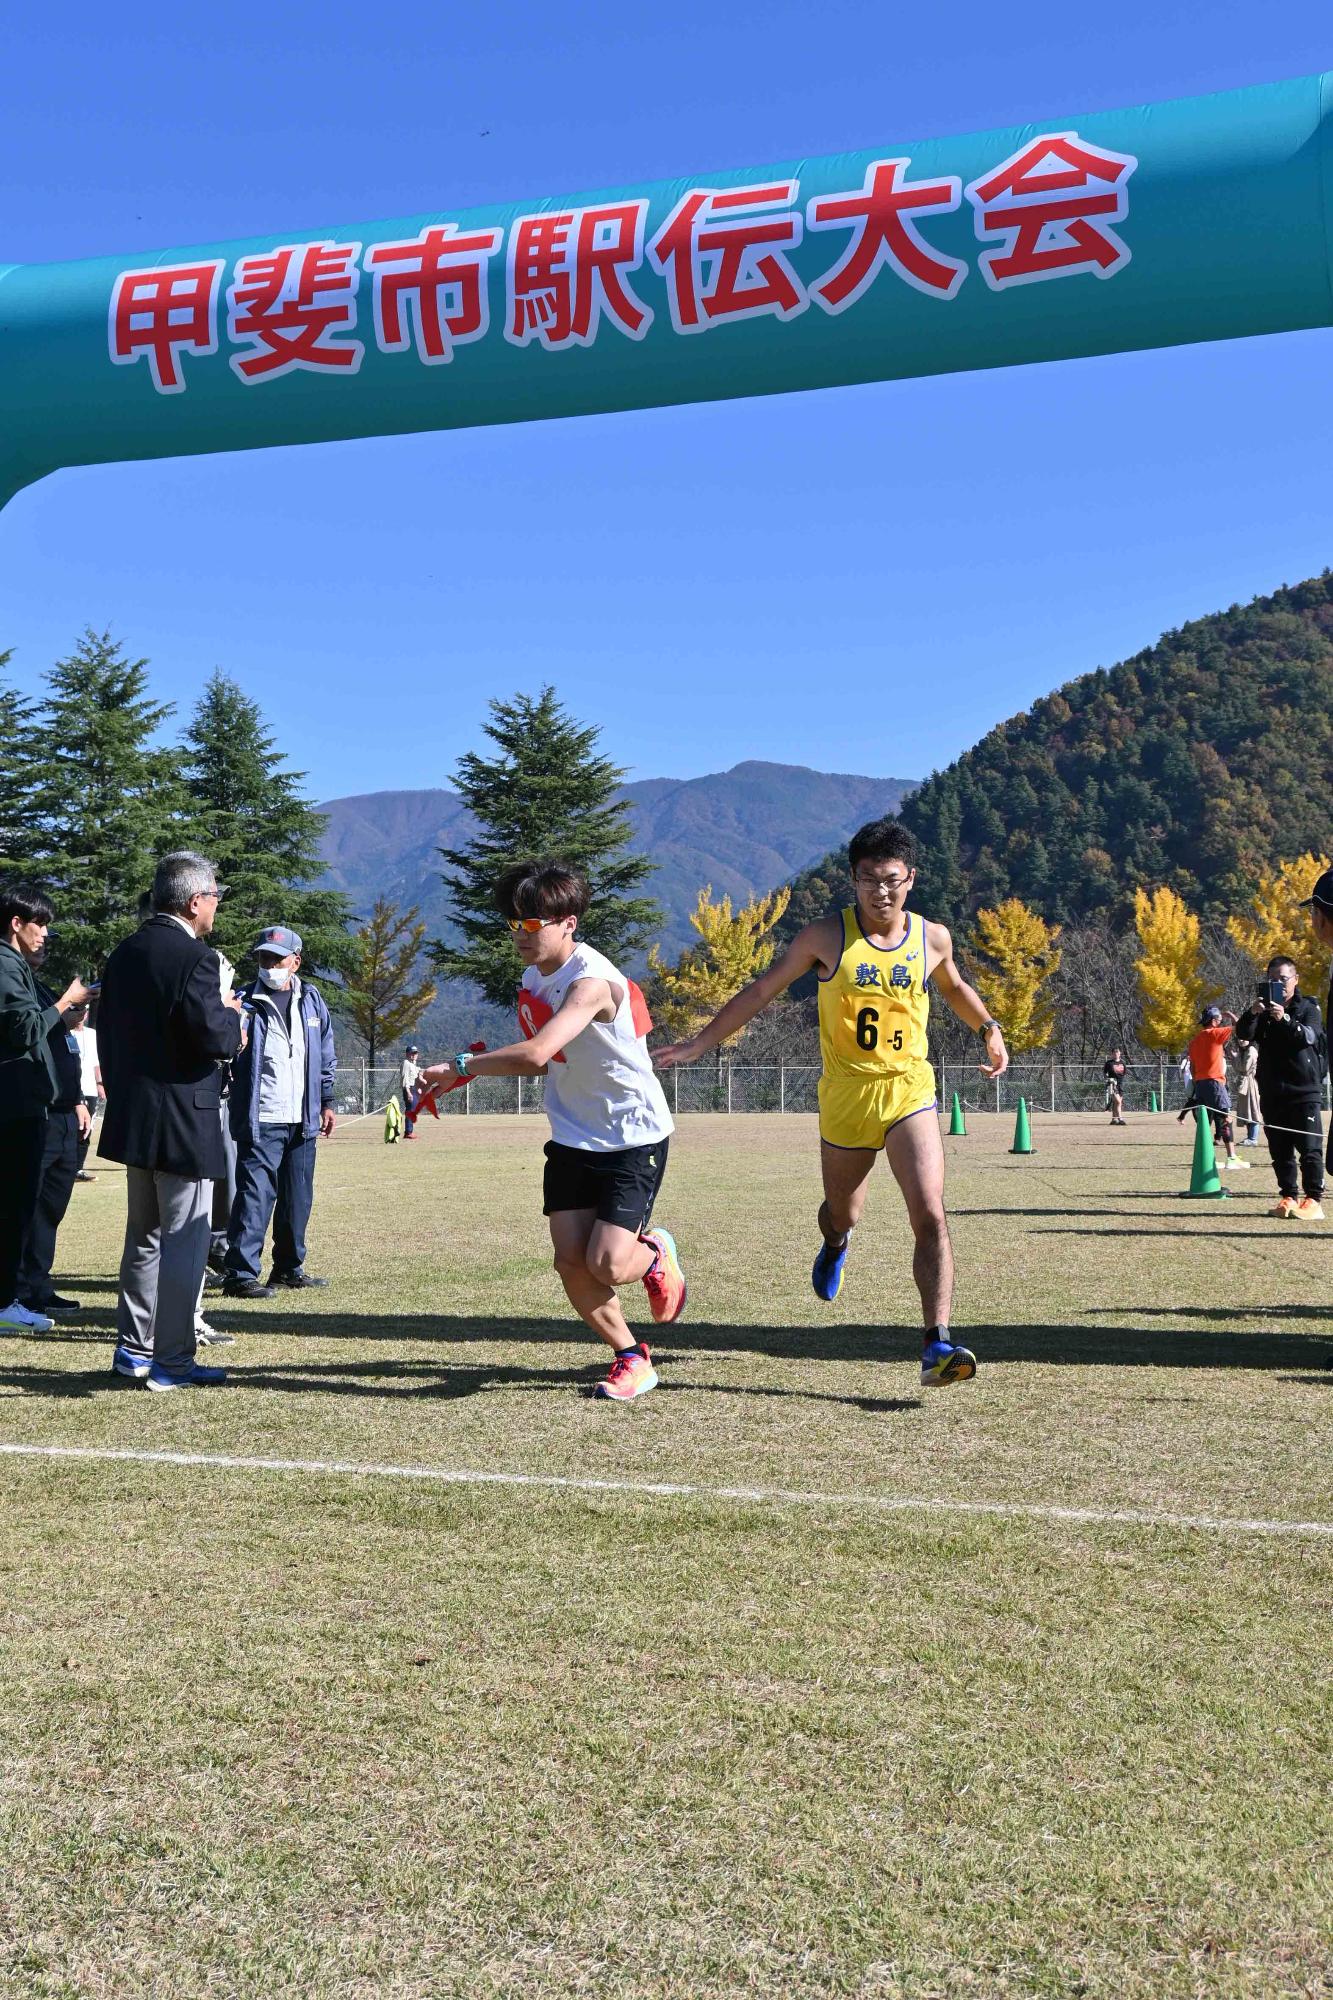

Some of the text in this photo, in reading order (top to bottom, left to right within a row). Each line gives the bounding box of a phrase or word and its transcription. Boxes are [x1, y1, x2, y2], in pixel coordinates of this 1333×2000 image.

[111, 134, 1133, 390] 甲斐市駅伝大会
[855, 963, 911, 989] 敷島
